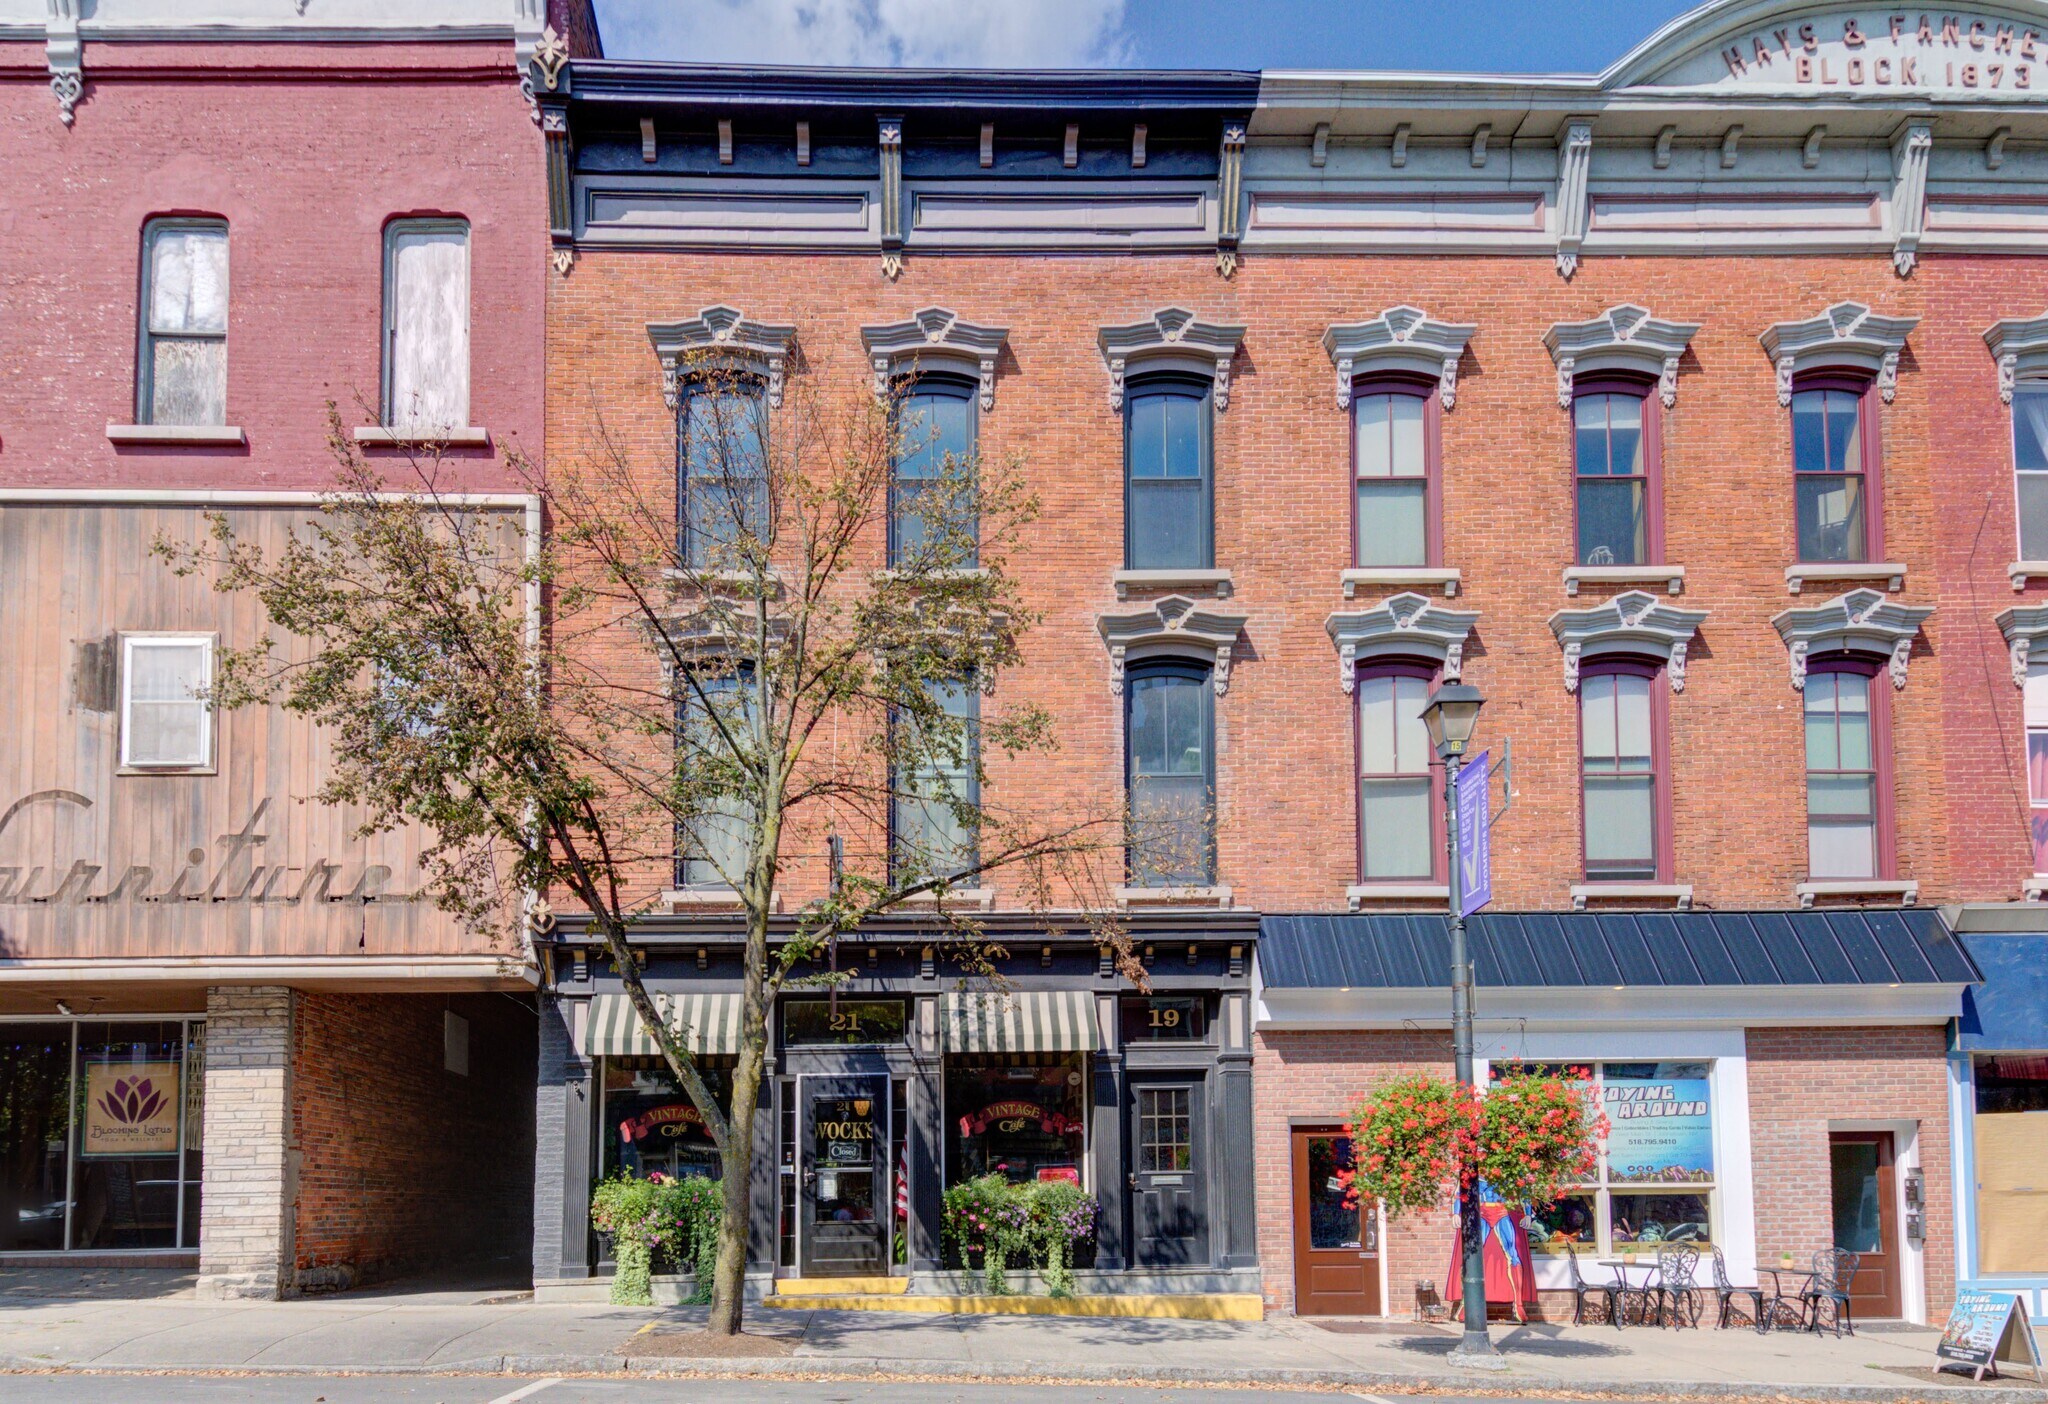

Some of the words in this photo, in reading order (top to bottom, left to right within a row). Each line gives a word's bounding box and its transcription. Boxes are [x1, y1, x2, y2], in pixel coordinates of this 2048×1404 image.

[1722, 23, 1819, 78] HAYS
[1844, 18, 1867, 47] &
[1889, 14, 2048, 61] FANCHE
[1796, 56, 1917, 85] BLOCK
[1946, 62, 2031, 89] 1873
[1452, 742, 1461, 750] 15
[1480, 763, 1489, 829] EQUALITY
[0, 789, 395, 903] urniture
[1481, 831, 1489, 892] WOMEN'S
[829, 1013, 862, 1032] 21
[1148, 1009, 1180, 1028] 19
[986, 1103, 1041, 1119] VINTAGE
[1617, 1100, 1709, 1119] AROUND
[831, 1146, 857, 1157] Closed
[1960, 1294, 1992, 1304] TOYING
